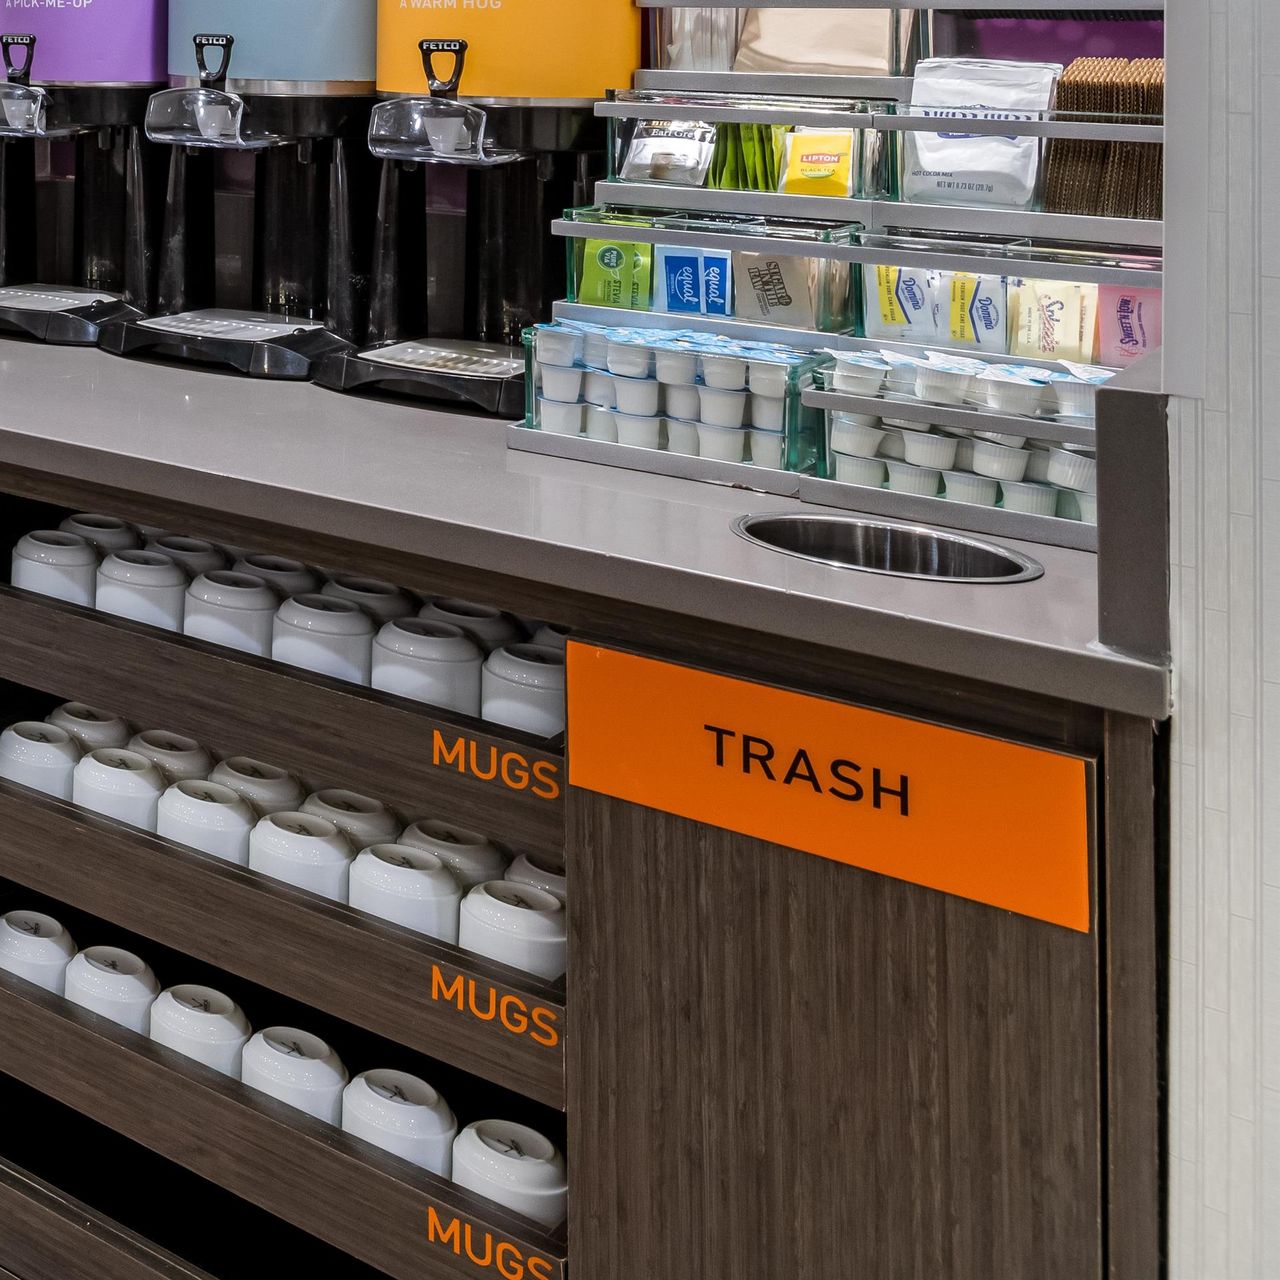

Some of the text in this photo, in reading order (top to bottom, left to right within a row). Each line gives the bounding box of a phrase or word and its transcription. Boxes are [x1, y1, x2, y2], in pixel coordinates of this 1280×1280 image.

[2, 36, 30, 44] FETCO
[196, 36, 227, 45] FETCO
[423, 41, 460, 50] FETCO
[651, 129, 697, 139] Earl Gre
[947, 181, 955, 189] WT
[613, 279, 622, 304] STEVIA
[682, 266, 699, 304] equal
[903, 277, 922, 311] Domino
[978, 297, 994, 330] Domino
[1117, 298, 1134, 314] LOW
[433, 729, 560, 800] MUGS
[704, 725, 910, 817] TRASH
[431, 965, 559, 1046] MUGS
[428, 1206, 553, 1280] MUGS
